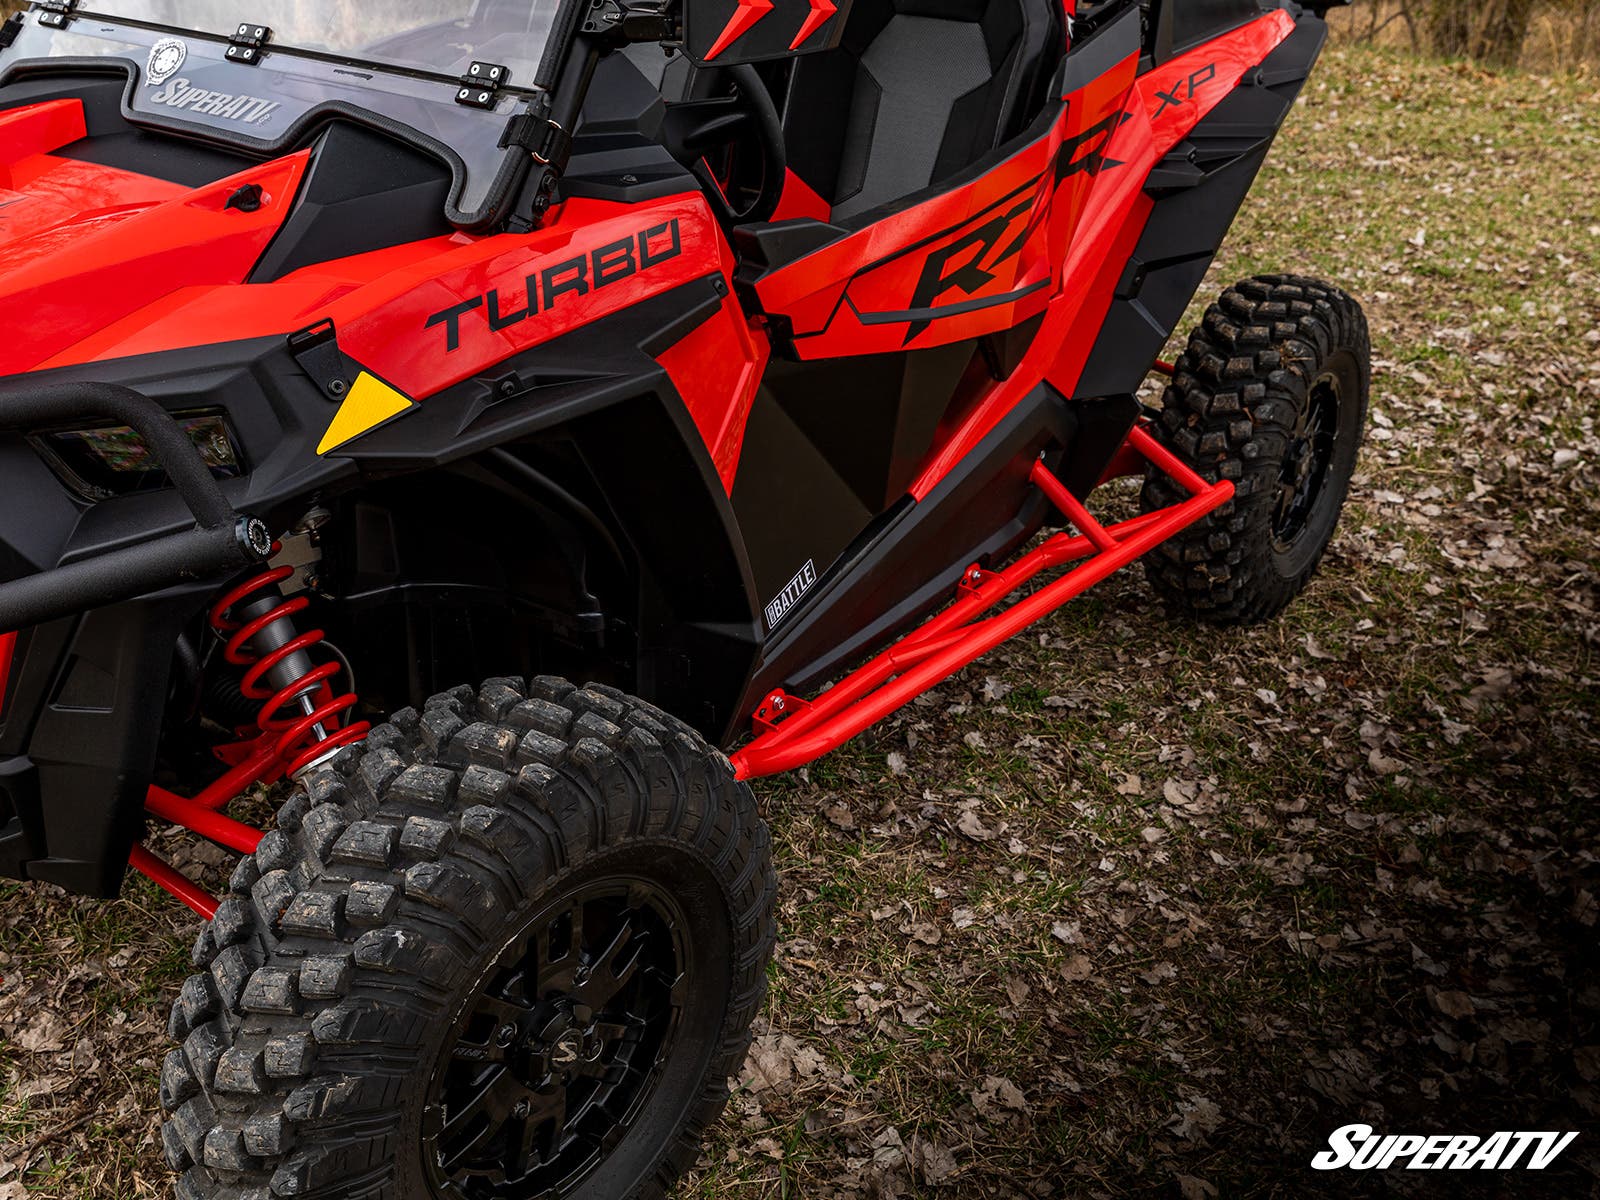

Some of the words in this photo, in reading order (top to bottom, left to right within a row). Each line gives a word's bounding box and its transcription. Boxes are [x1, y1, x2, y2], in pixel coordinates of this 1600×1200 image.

[1152, 63, 1215, 120] XP
[424, 217, 682, 353] TURBO
[773, 563, 813, 619] BATTLE
